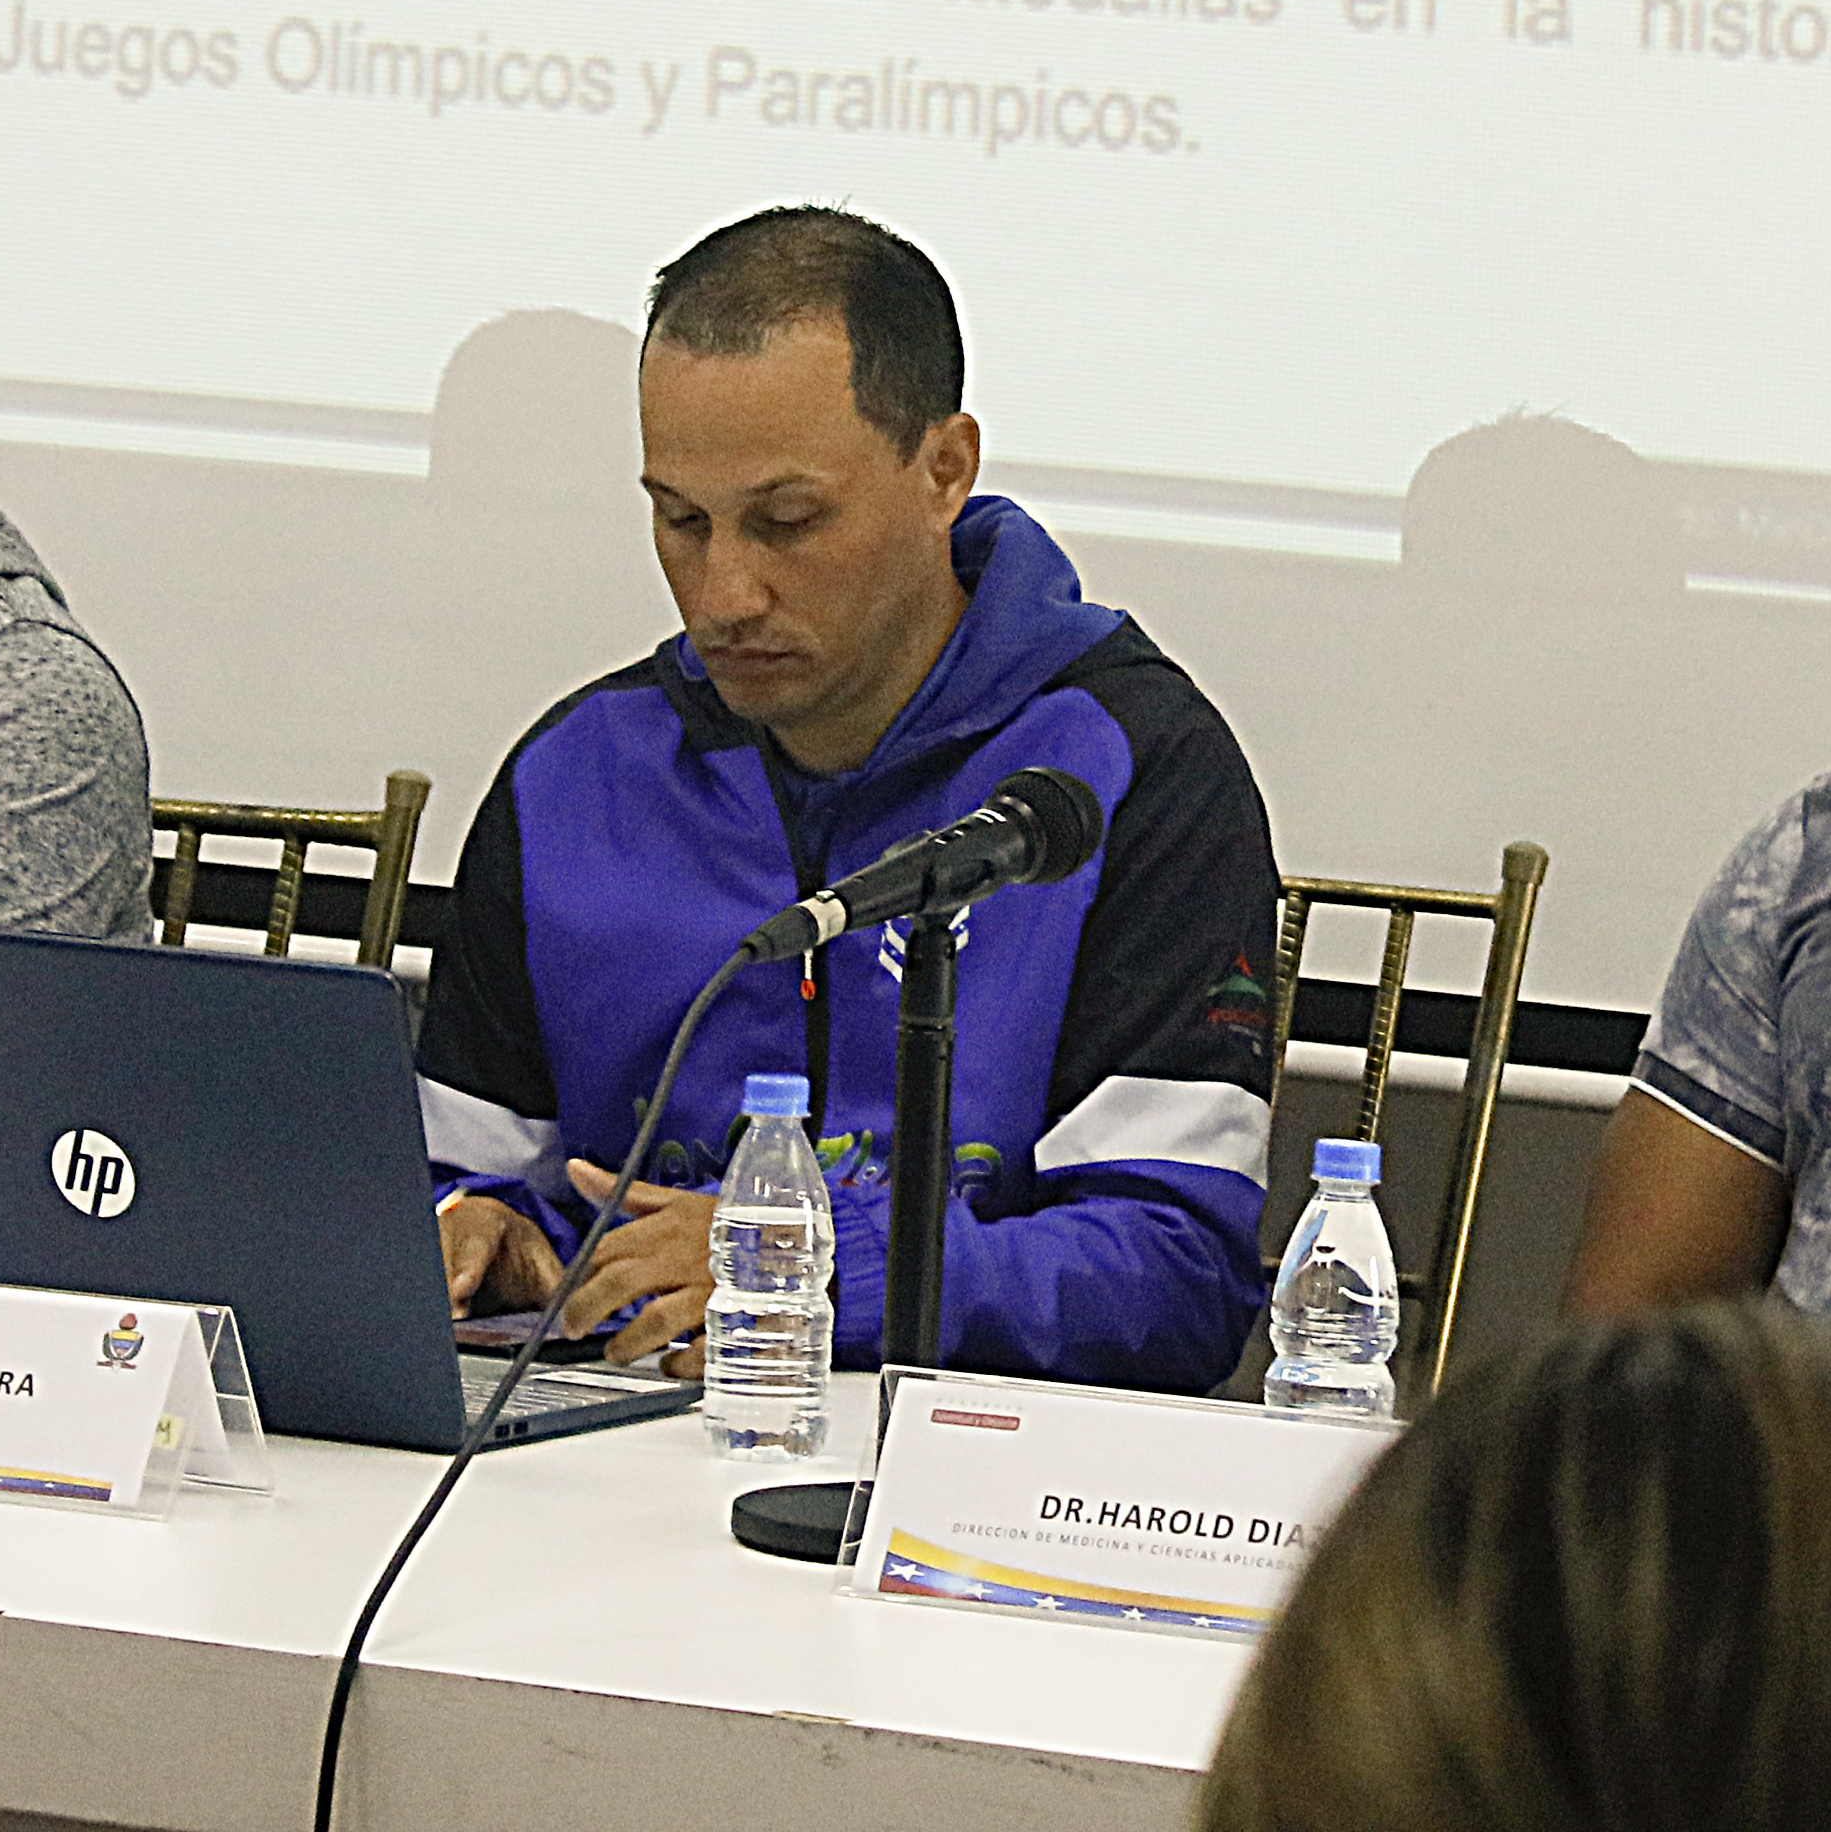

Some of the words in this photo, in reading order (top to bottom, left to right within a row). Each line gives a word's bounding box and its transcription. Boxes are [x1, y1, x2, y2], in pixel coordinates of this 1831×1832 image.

[265, 16, 615, 118] Olímpicos
[641, 62, 680, 137] y
[706, 46, 1199, 157] Paralímpicos.
[61, 1129, 127, 1218] hp
[952, 1522, 1029, 1541] DIRECCION
[1035, 1531, 1052, 1543] DE
[1059, 1534, 1130, 1552] MEDICINA
[1150, 1544, 1216, 1562] CIENCIAS
[1040, 1494, 1234, 1540] DR.HAROLD
[1247, 1518, 1318, 1552] DIA
